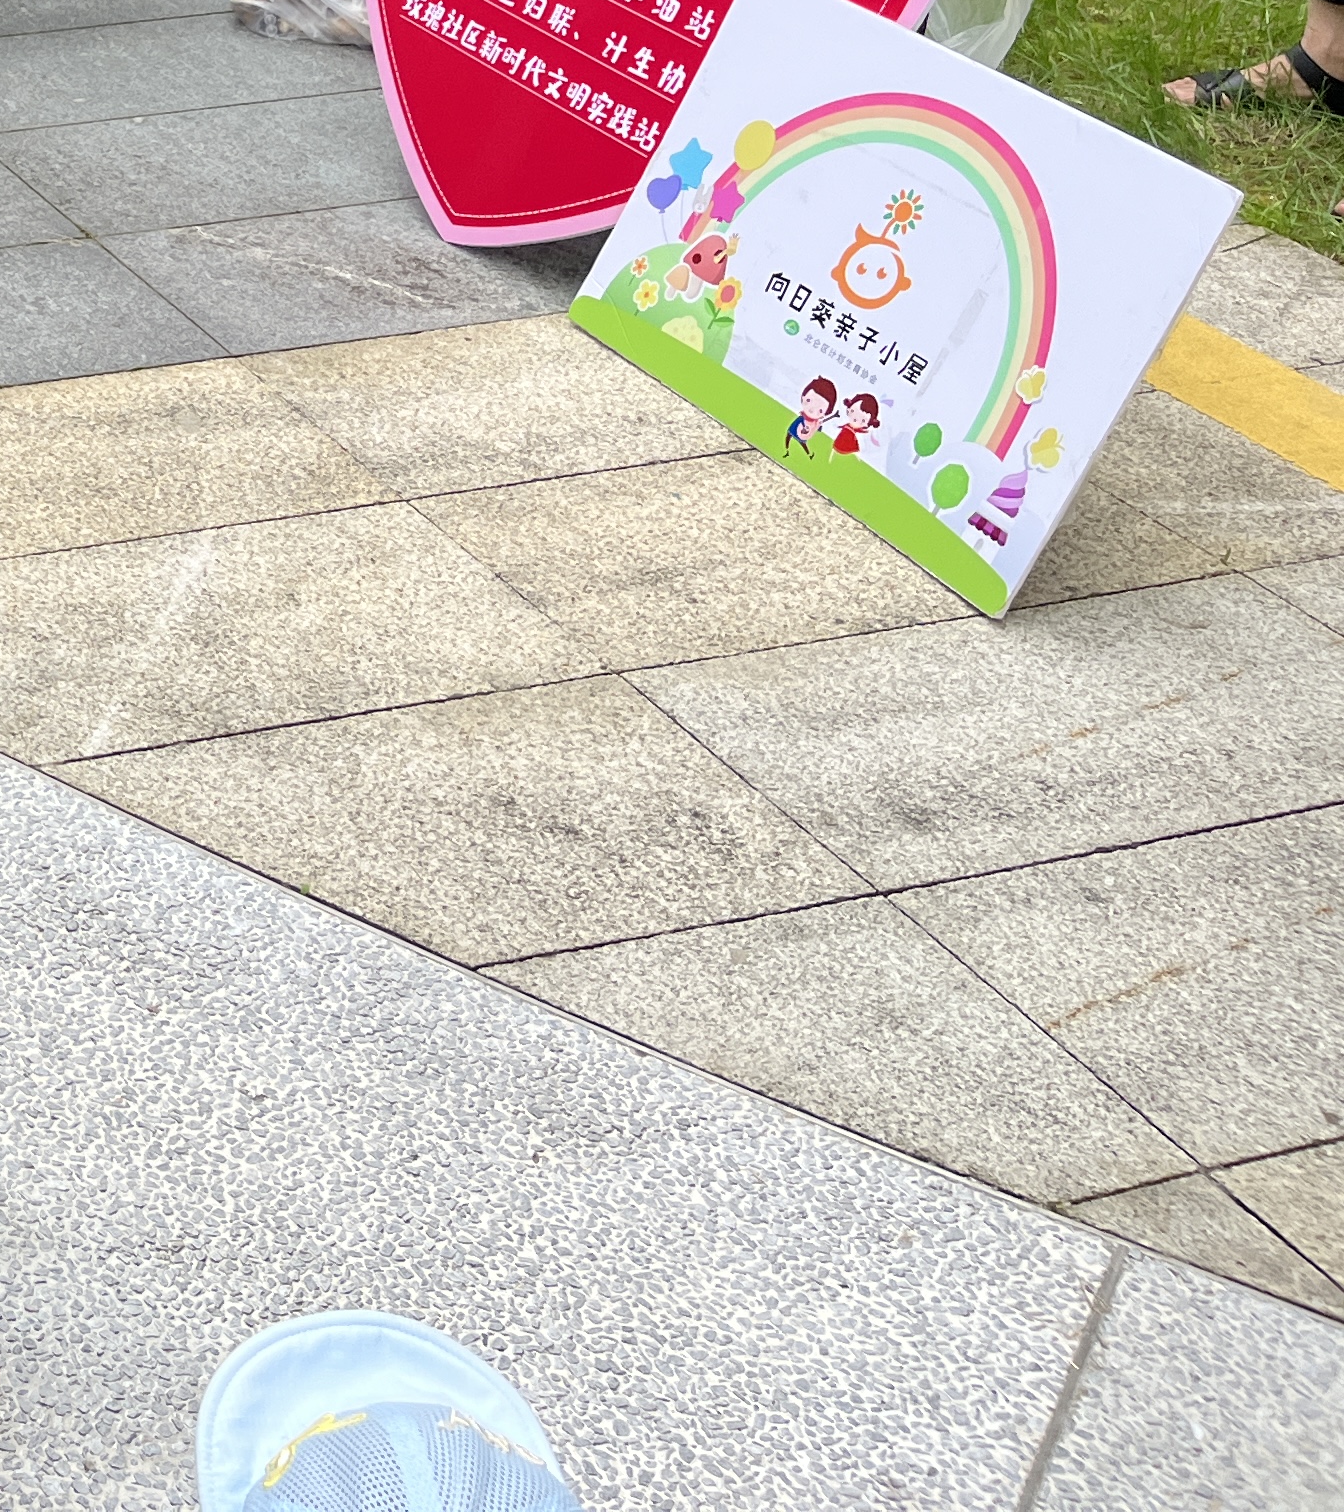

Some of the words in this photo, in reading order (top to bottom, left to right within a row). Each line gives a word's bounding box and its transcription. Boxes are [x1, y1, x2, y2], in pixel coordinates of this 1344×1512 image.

[764, 272, 929, 385] 向日葵亲子小屋
